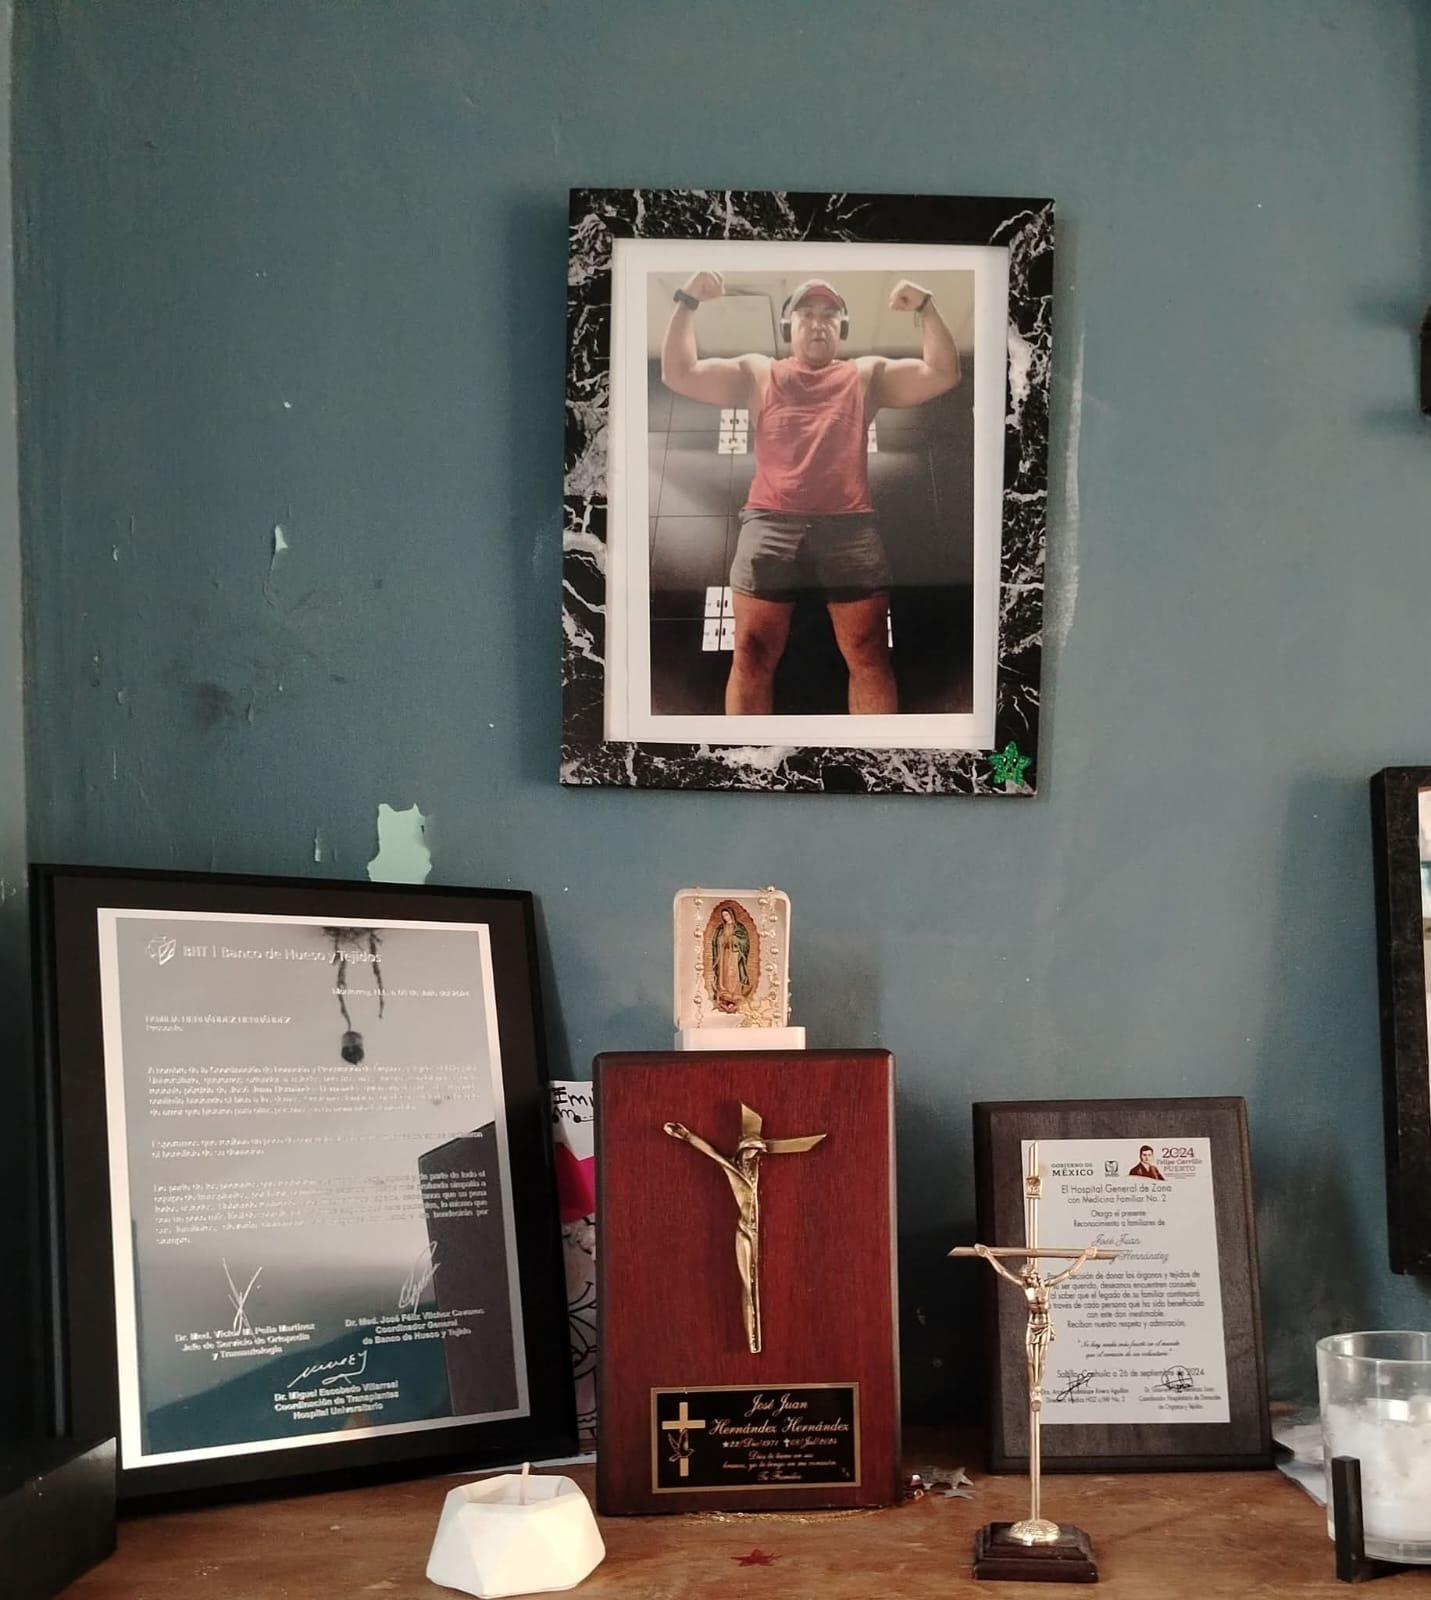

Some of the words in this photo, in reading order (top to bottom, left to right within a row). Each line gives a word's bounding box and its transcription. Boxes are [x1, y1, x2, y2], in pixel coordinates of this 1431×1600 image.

[222, 946, 262, 959] Banco
[265, 948, 282, 960] de
[285, 949, 326, 961] Hueso
[336, 950, 382, 965] Tejidos
[1161, 1146, 1195, 1158] 2024
[1052, 1167, 1094, 1176] MÉXICO
[1061, 1184, 1069, 1193] El
[1071, 1184, 1103, 1195] Hospital
[1105, 1183, 1137, 1193] General
[1139, 1184, 1149, 1193] de
[1151, 1183, 1173, 1193] Zona
[1067, 1196, 1081, 1204] con
[1082, 1194, 1115, 1203] Medicina
[1116, 1194, 1144, 1203] Familiar
[1146, 1194, 1159, 1202] No.
[1161, 1193, 1167, 1202] 2
[1091, 1209, 1113, 1219] Otorga
[1121, 1210, 1146, 1218] presente
[1073, 1219, 1120, 1228] Reconocimiento
[1095, 1271, 1104, 1279] de
[1106, 1271, 1124, 1279] donar
[1126, 1271, 1135, 1279] los
[1136, 1271, 1162, 1281] órganos
[1169, 1270, 1191, 1280] tejidos
[1192, 1269, 1200, 1278] de
[1100, 1280, 1132, 1289] deseamos
[1058, 1291, 1075, 1299] saber
[1077, 1293, 1089, 1301] que
[1099, 1290, 1121, 1301] legado
[1122, 1290, 1131, 1298] de
[1141, 1290, 1164, 1298] familiar
[1073, 1300, 1082, 1309] de
[1083, 1301, 1100, 1309] cada
[1101, 1302, 1127, 1311] persona
[1128, 1302, 1140, 1310] que
[344, 1318, 358, 1327] Dr.
[358, 1317, 379, 1326] Med.
[380, 1315, 401, 1324] José
[375, 1323, 426, 1334] Coordinador
[427, 1319, 458, 1330] General
[1067, 1319, 1093, 1328] Reciban
[182, 1343, 202, 1352] Jefe
[203, 1341, 215, 1349] de
[216, 1339, 253, 1348] Servicio
[254, 1337, 266, 1345] de
[267, 1333, 311, 1344] Ortopedia
[362, 1336, 374, 1345] de
[374, 1334, 401, 1344] Banco
[402, 1332, 413, 1341] de
[414, 1330, 440, 1340] Hueso
[1119, 1368, 1129, 1377] 26
[1130, 1368, 1139, 1377] de
[1186, 1367, 1205, 1377] 2024
[274, 1393, 287, 1402] Dr.
[288, 1388, 318, 1401] Miguel
[319, 1384, 362, 1397] Escobedo
[362, 1380, 399, 1392] Villarreal
[274, 1398, 333, 1412] Coordinación
[334, 1395, 345, 1405] de
[744, 1393, 774, 1417] José
[772, 1393, 808, 1417] Juan
[293, 1408, 329, 1420] Hospital
[330, 1402, 384, 1415] Universitario
[708, 1418, 777, 1436] Hernández
[781, 1416, 849, 1433] Hernández
